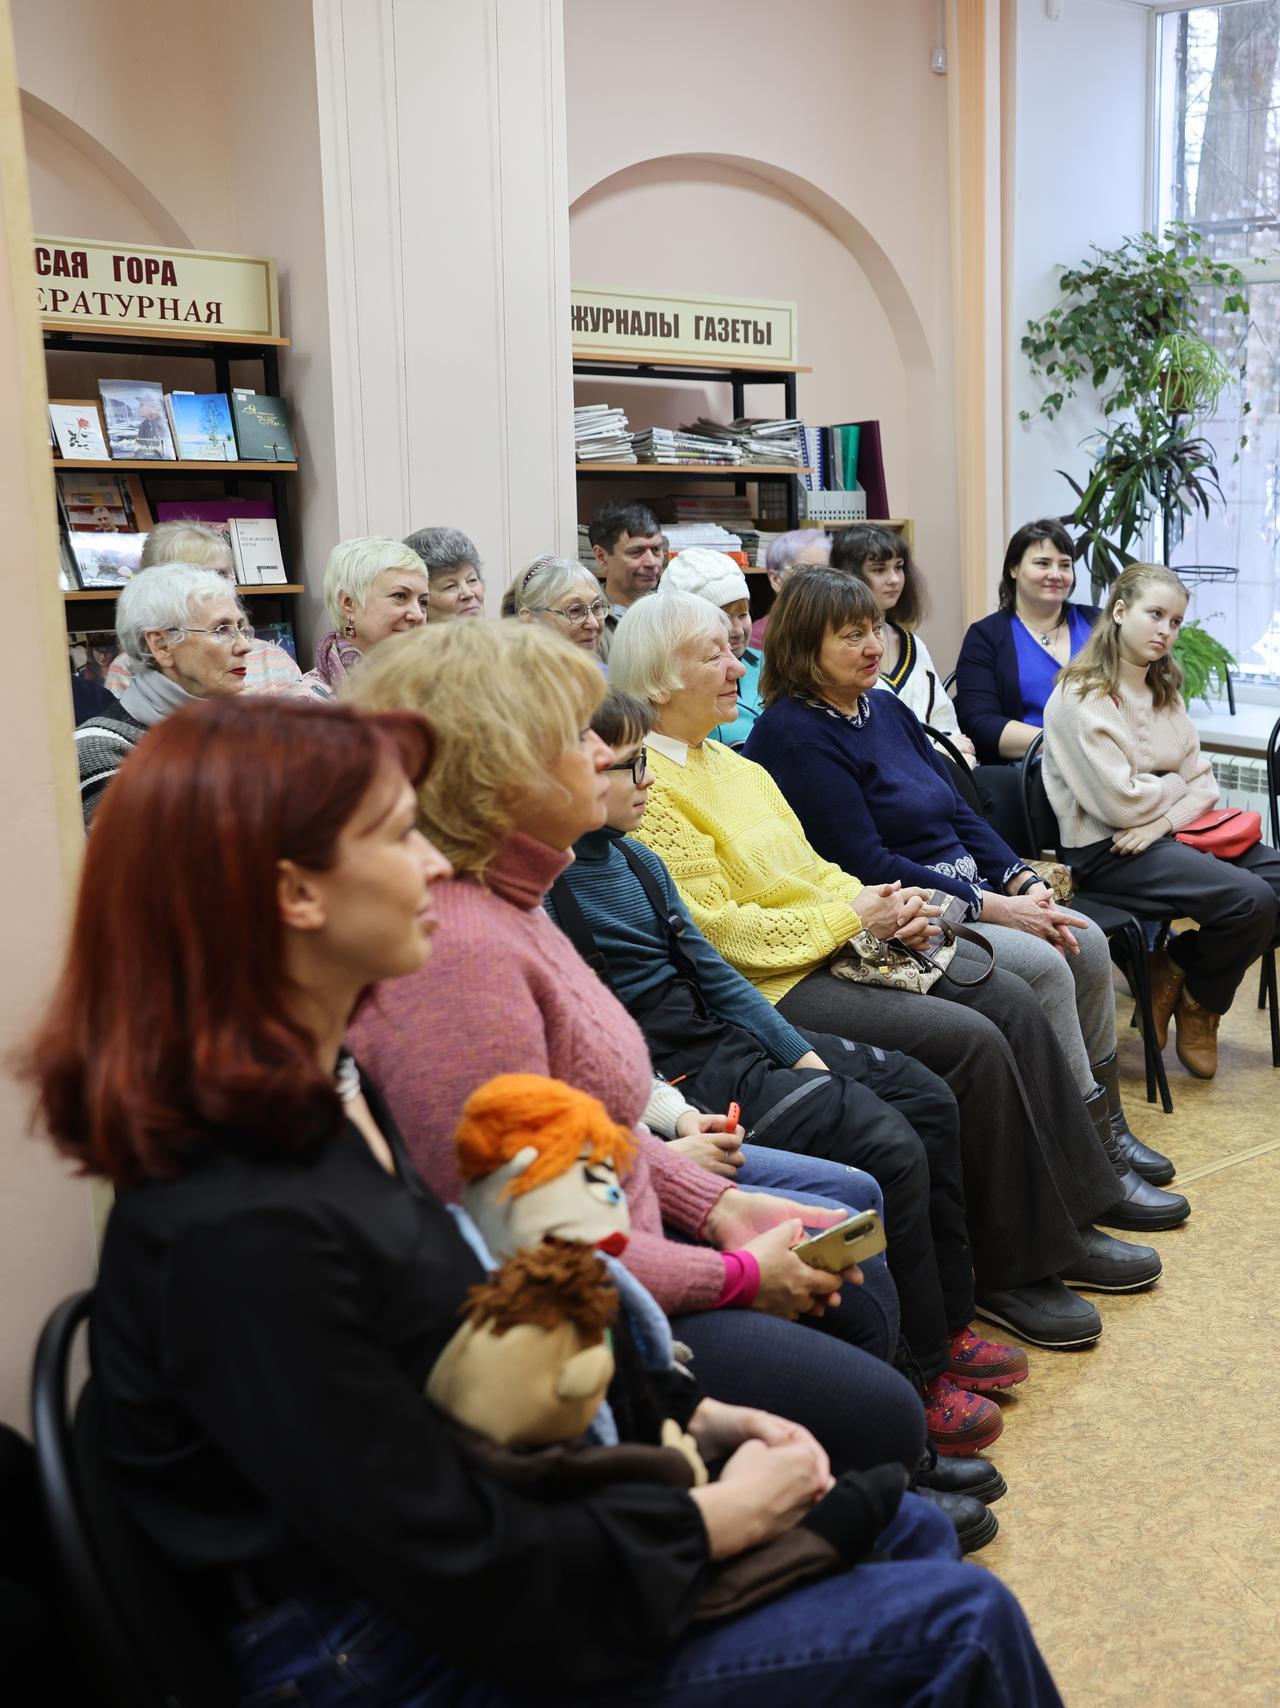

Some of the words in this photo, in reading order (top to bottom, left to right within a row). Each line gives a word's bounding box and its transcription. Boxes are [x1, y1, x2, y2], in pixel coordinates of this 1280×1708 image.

[34, 247, 88, 279] САЯ
[113, 255, 178, 287] ГОРА
[571, 304, 680, 339] ЖУРНАЛЫ
[694, 315, 772, 346] ГАЗЕТЫ
